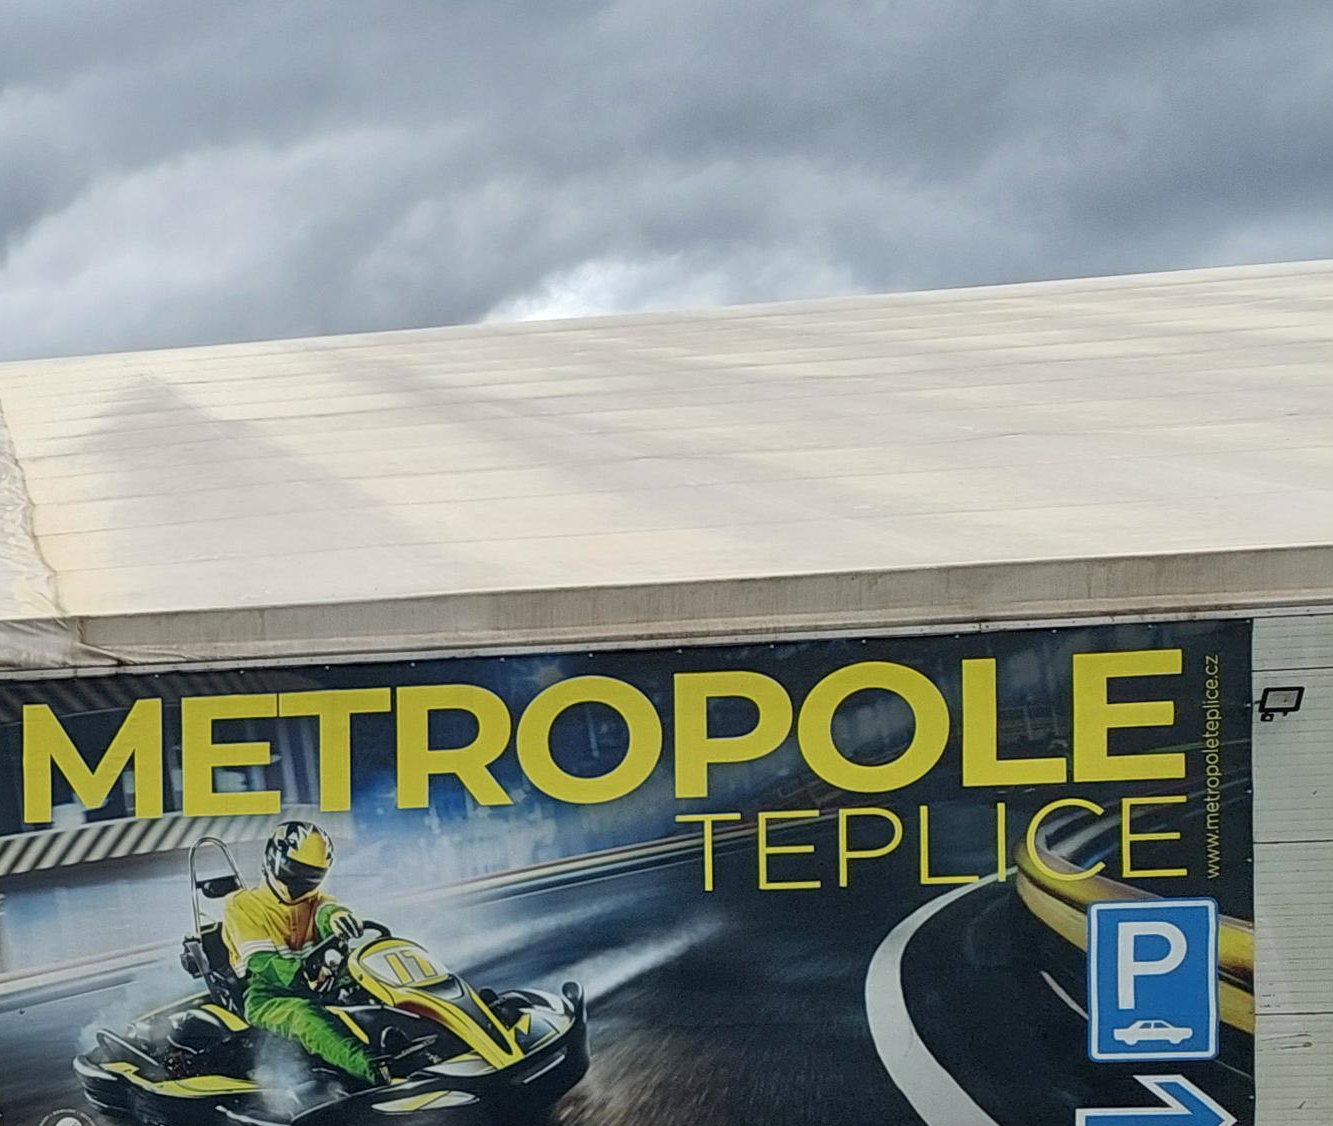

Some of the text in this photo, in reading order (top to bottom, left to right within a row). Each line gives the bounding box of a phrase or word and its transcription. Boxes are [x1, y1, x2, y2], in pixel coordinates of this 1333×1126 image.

[23, 649, 1186, 824] METROPOLE
[1202, 654, 1222, 879] www.metropoleteplice.cz
[675, 795, 1187, 891] TEPLICE
[1117, 921, 1188, 1010] P
